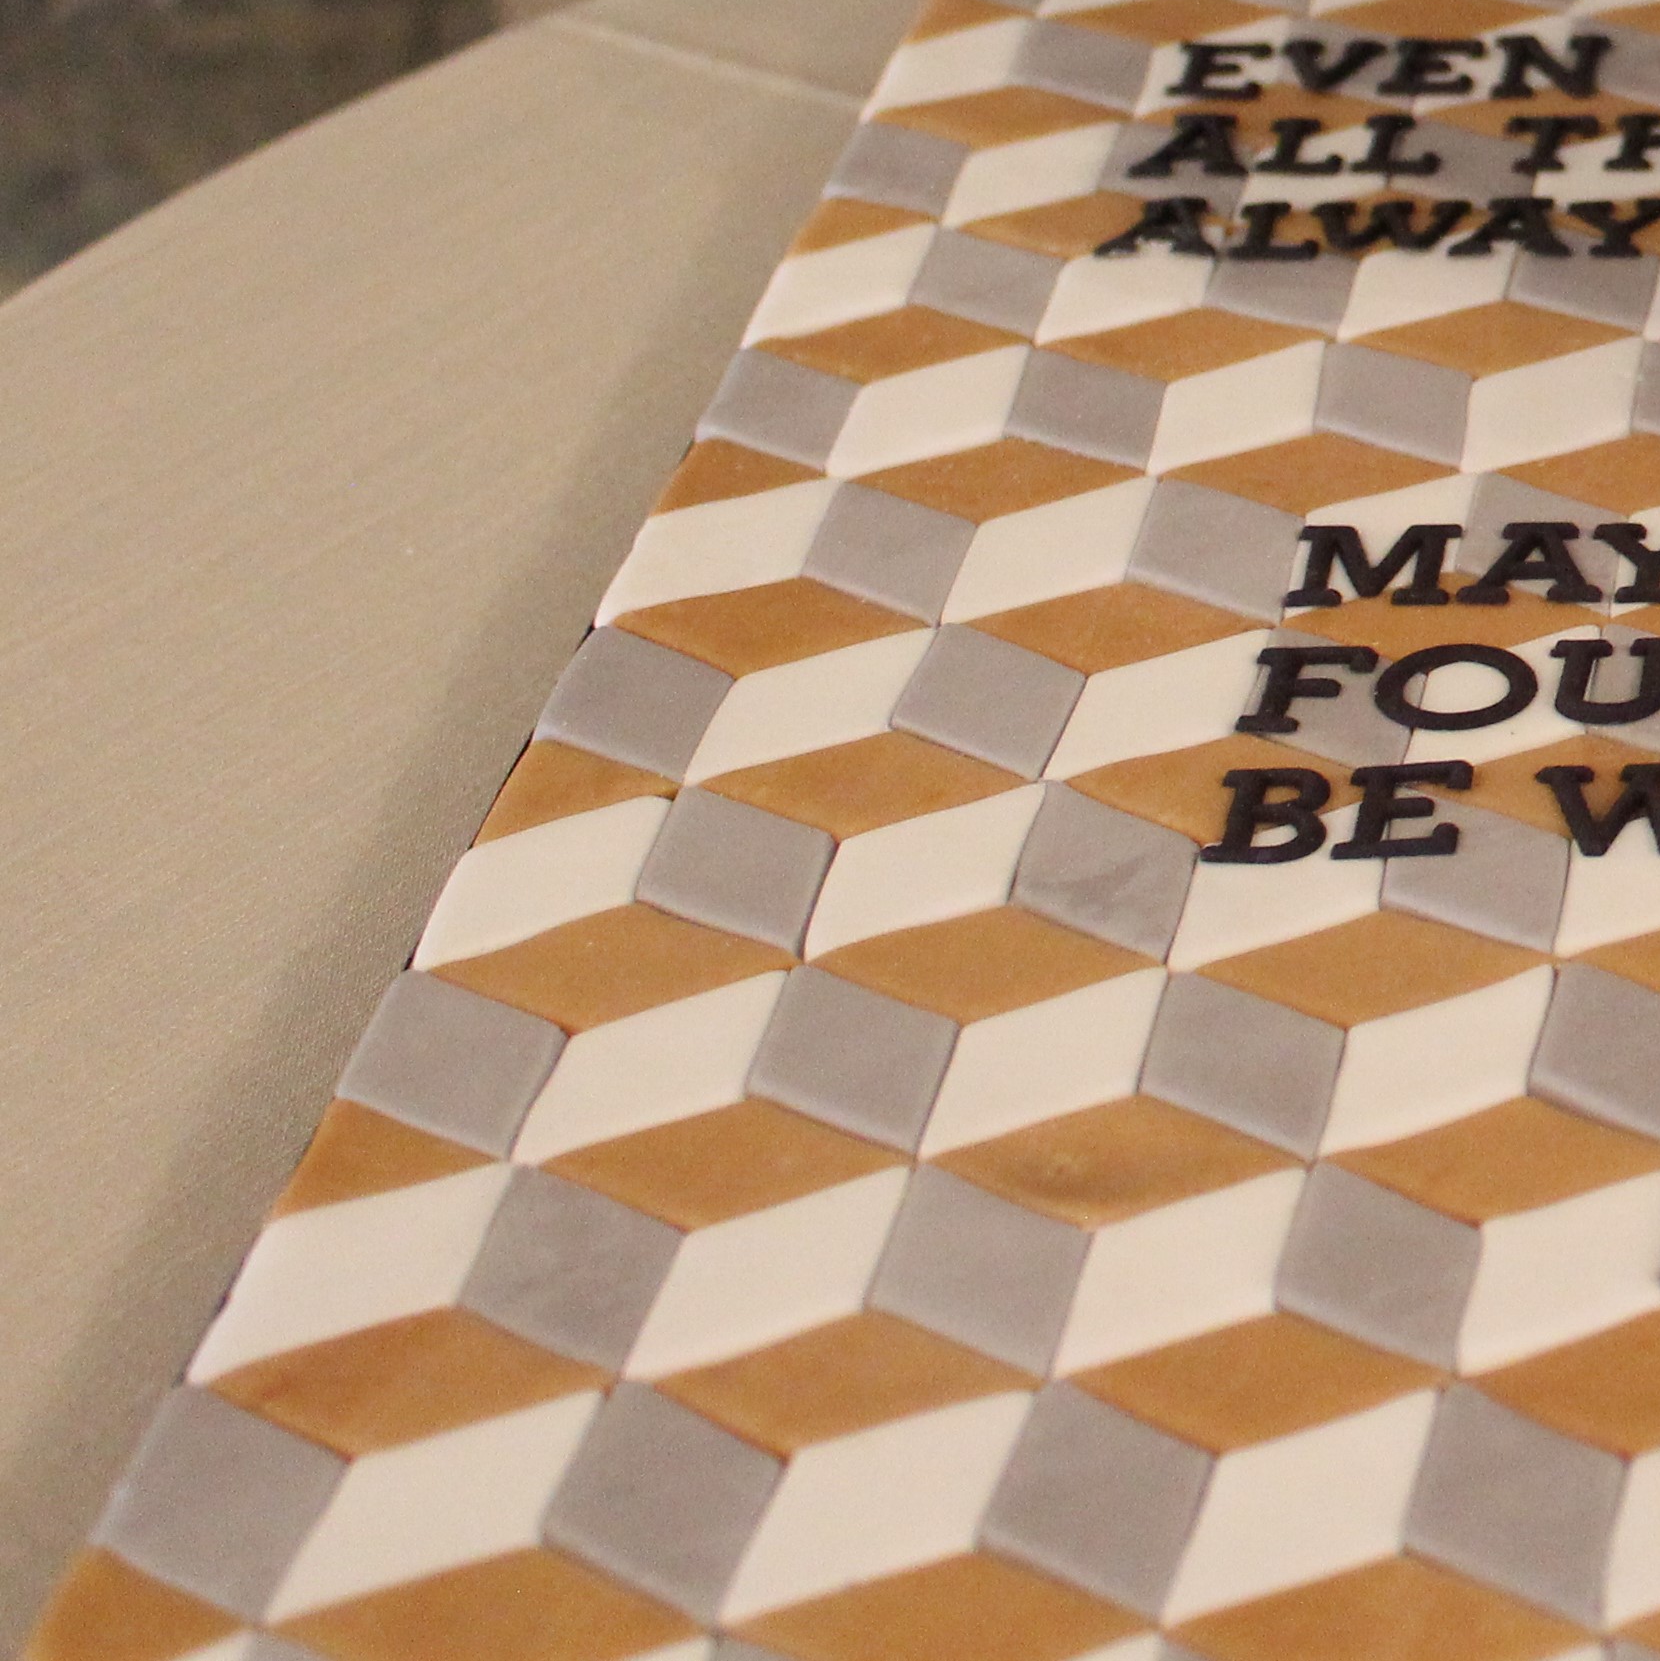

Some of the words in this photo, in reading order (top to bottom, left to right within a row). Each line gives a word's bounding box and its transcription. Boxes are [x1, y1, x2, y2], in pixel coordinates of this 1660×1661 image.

[1167, 35, 1616, 100] EVEN
[1127, 109, 1445, 181] ALL
[1198, 759, 1476, 866] BE
